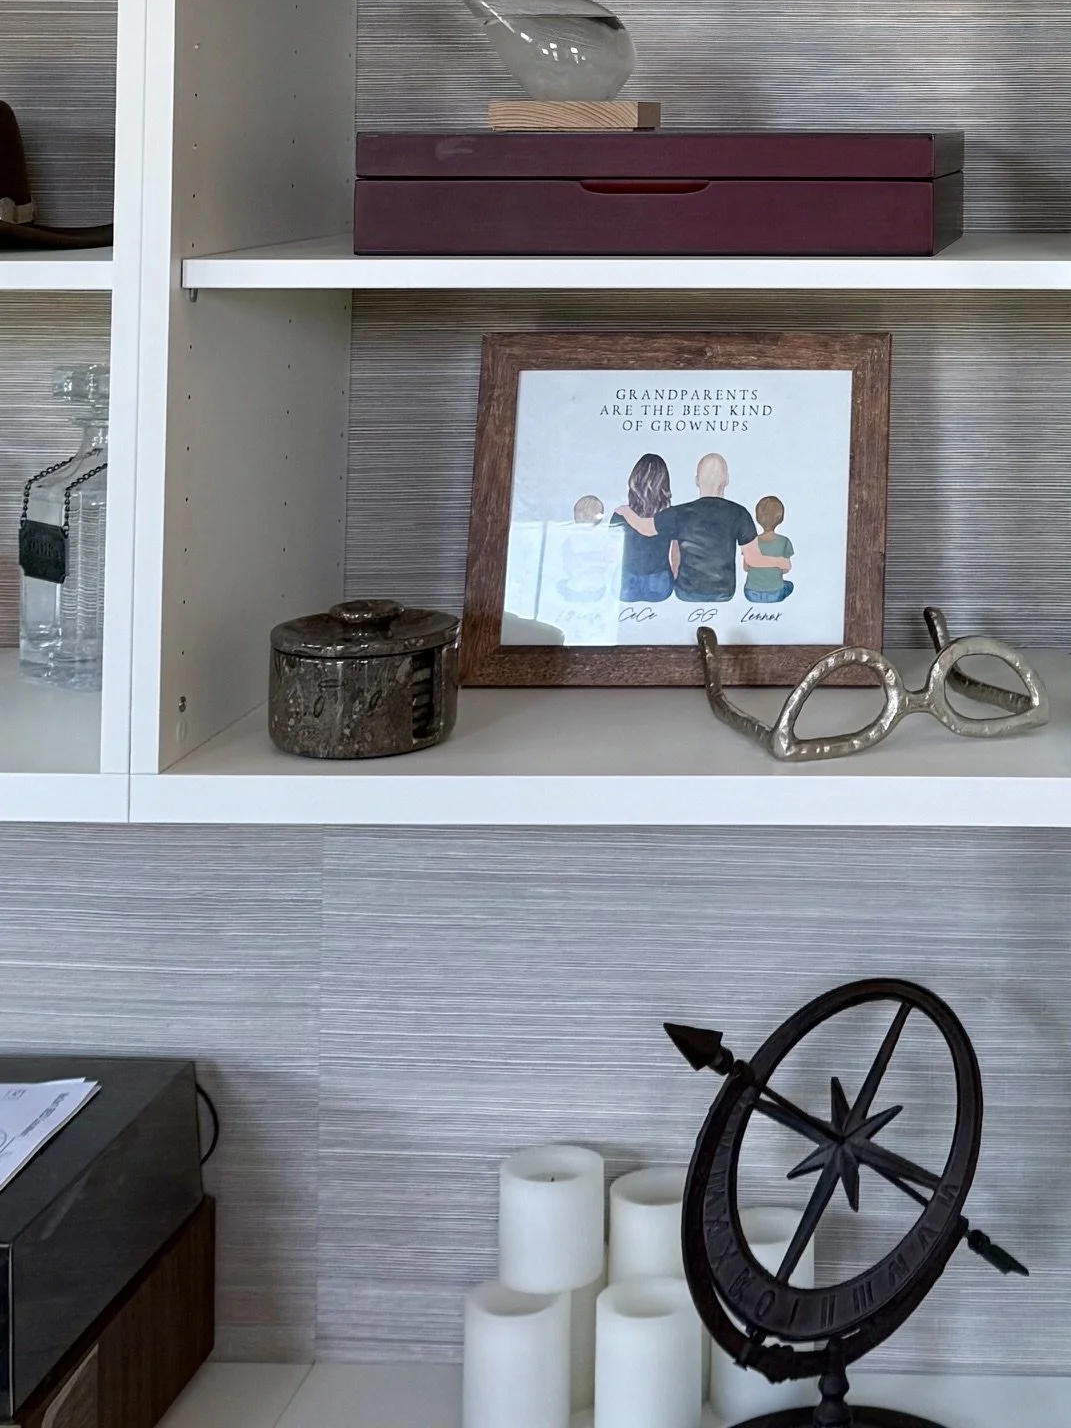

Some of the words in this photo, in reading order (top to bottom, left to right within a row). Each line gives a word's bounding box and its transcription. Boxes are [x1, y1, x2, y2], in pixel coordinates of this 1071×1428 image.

[615, 388, 759, 401] GRANDPARENTS
[599, 404, 633, 417] ARE
[641, 404, 675, 417] THE
[683, 404, 722, 417] BEST
[729, 404, 773, 417] KIND
[622, 420, 644, 432] OF
[650, 420, 749, 433] GROWNUPS
